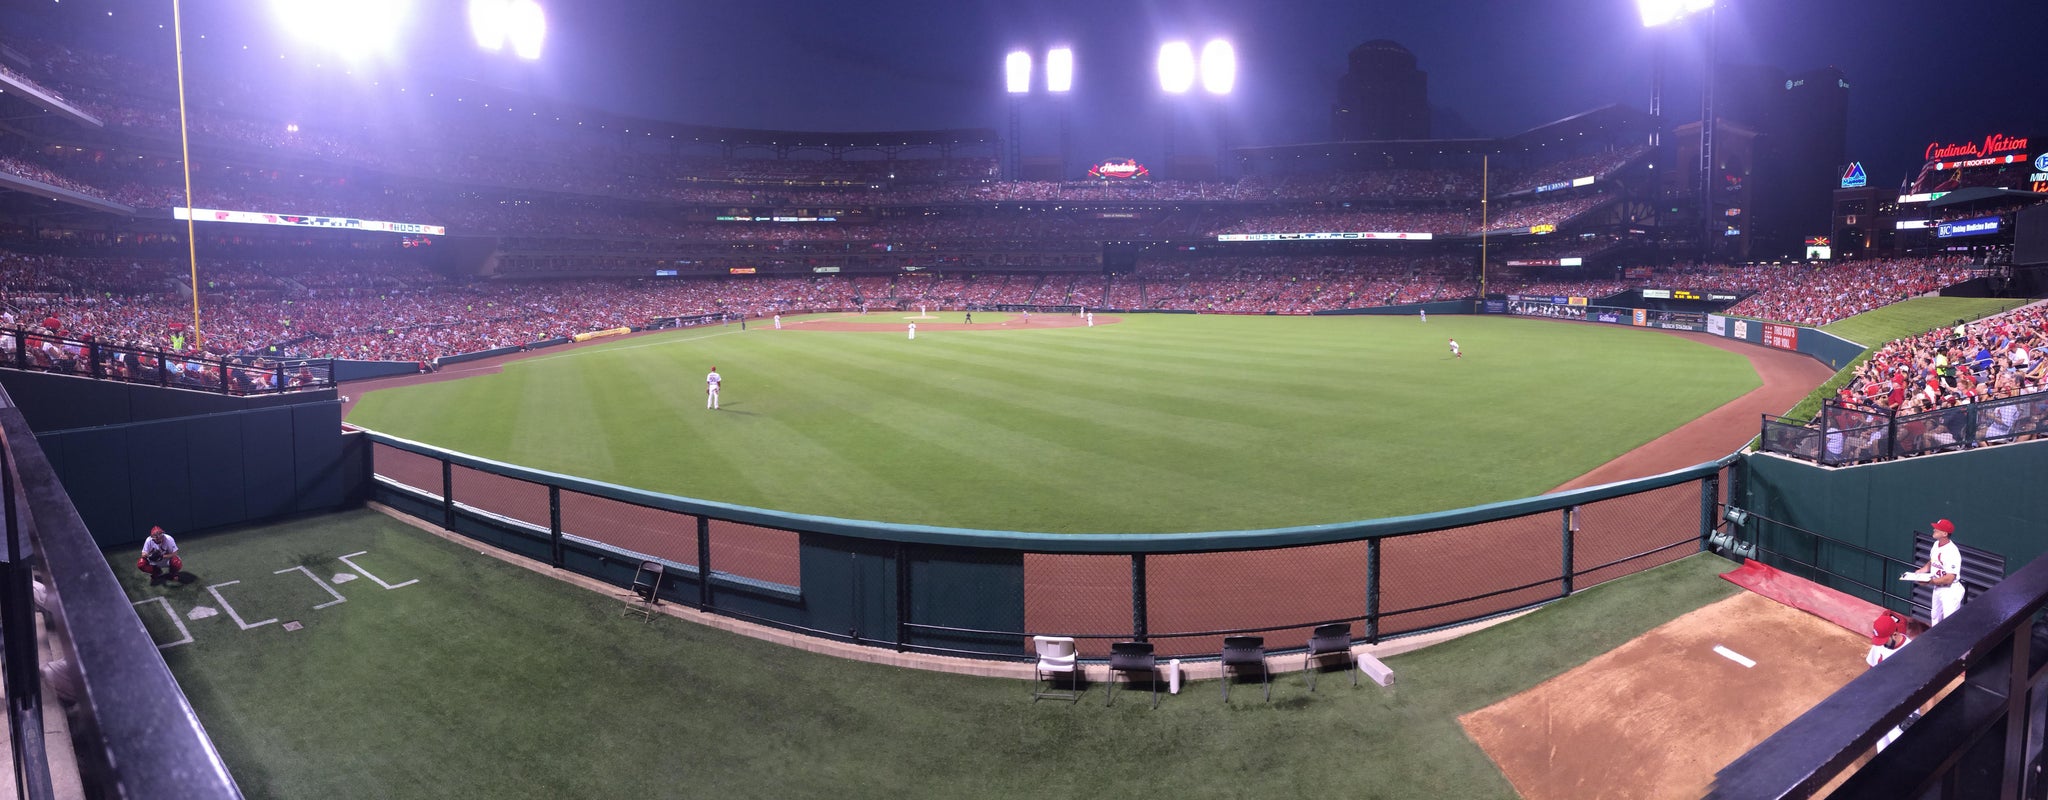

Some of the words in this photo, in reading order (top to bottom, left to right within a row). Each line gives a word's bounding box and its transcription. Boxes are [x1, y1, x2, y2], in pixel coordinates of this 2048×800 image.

[1976, 133, 2028, 157] Nation
[1966, 157, 1996, 168] ROOFTOP
[2030, 173, 2048, 182] MID
[1940, 225, 1951, 237] BJC
[1966, 223, 1984, 231] Medicine
[1984, 222, 1998, 230] Better
[1773, 325, 1782, 336] THIS
[1783, 326, 1795, 338] BUD'S
[1773, 336, 1781, 346] FOR
